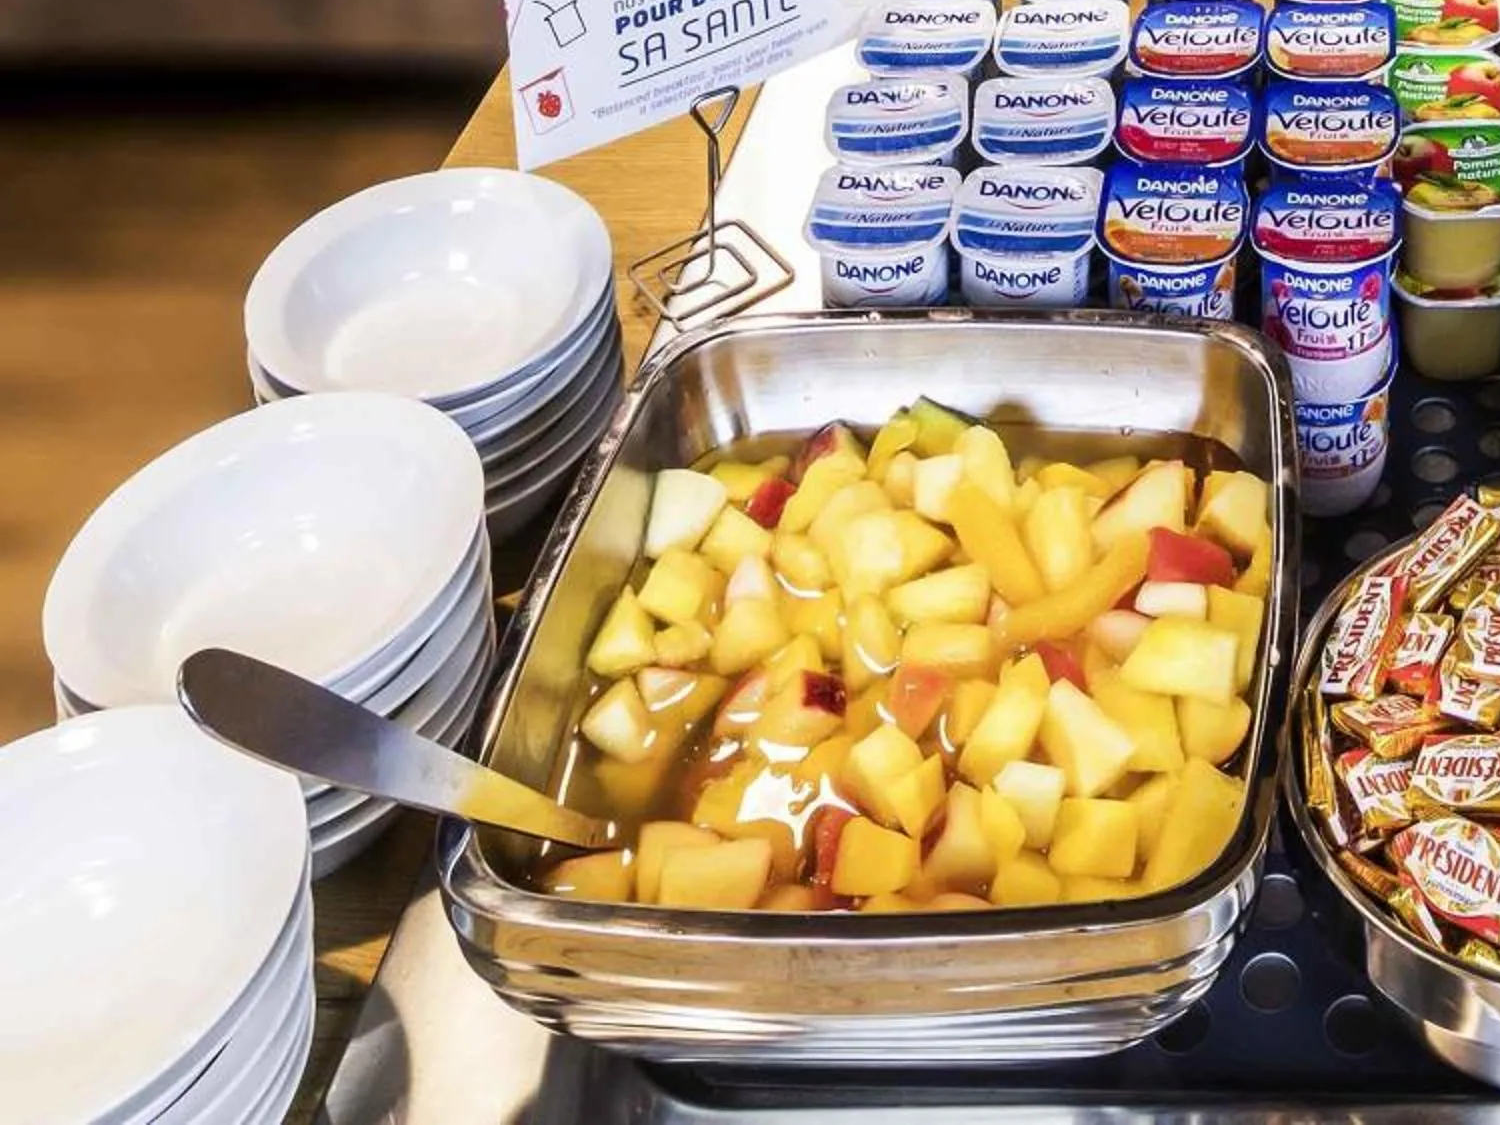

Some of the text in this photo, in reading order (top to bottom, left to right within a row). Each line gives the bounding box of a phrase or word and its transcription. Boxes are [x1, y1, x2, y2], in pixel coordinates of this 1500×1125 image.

[885, 10, 981, 25] DANONE
[1165, 12, 1240, 25] DANONE
[1292, 12, 1365, 25] DANONE
[1146, 26, 1257, 47] Velouté
[1275, 25, 1388, 47] Velouté
[618, 31, 668, 77] SA
[995, 89, 1096, 109] DANONE
[1151, 88, 1229, 102] DANONE
[1293, 94, 1371, 107] DANONE
[1131, 103, 1248, 127] Velouté
[1277, 109, 1393, 132] Velouté
[979, 179, 1088, 200] DANONE
[1137, 178, 1219, 195] DANONE
[1115, 195, 1241, 222] Velouté
[1287, 192, 1369, 205] DANONE
[1268, 208, 1392, 230] Velouté
[836, 255, 925, 282] DANONE
[975, 260, 1061, 287] DANONE
[1137, 273, 1207, 290] DANONE
[1283, 273, 1353, 292] DANONE
[1296, 405, 1354, 421] ANONE
